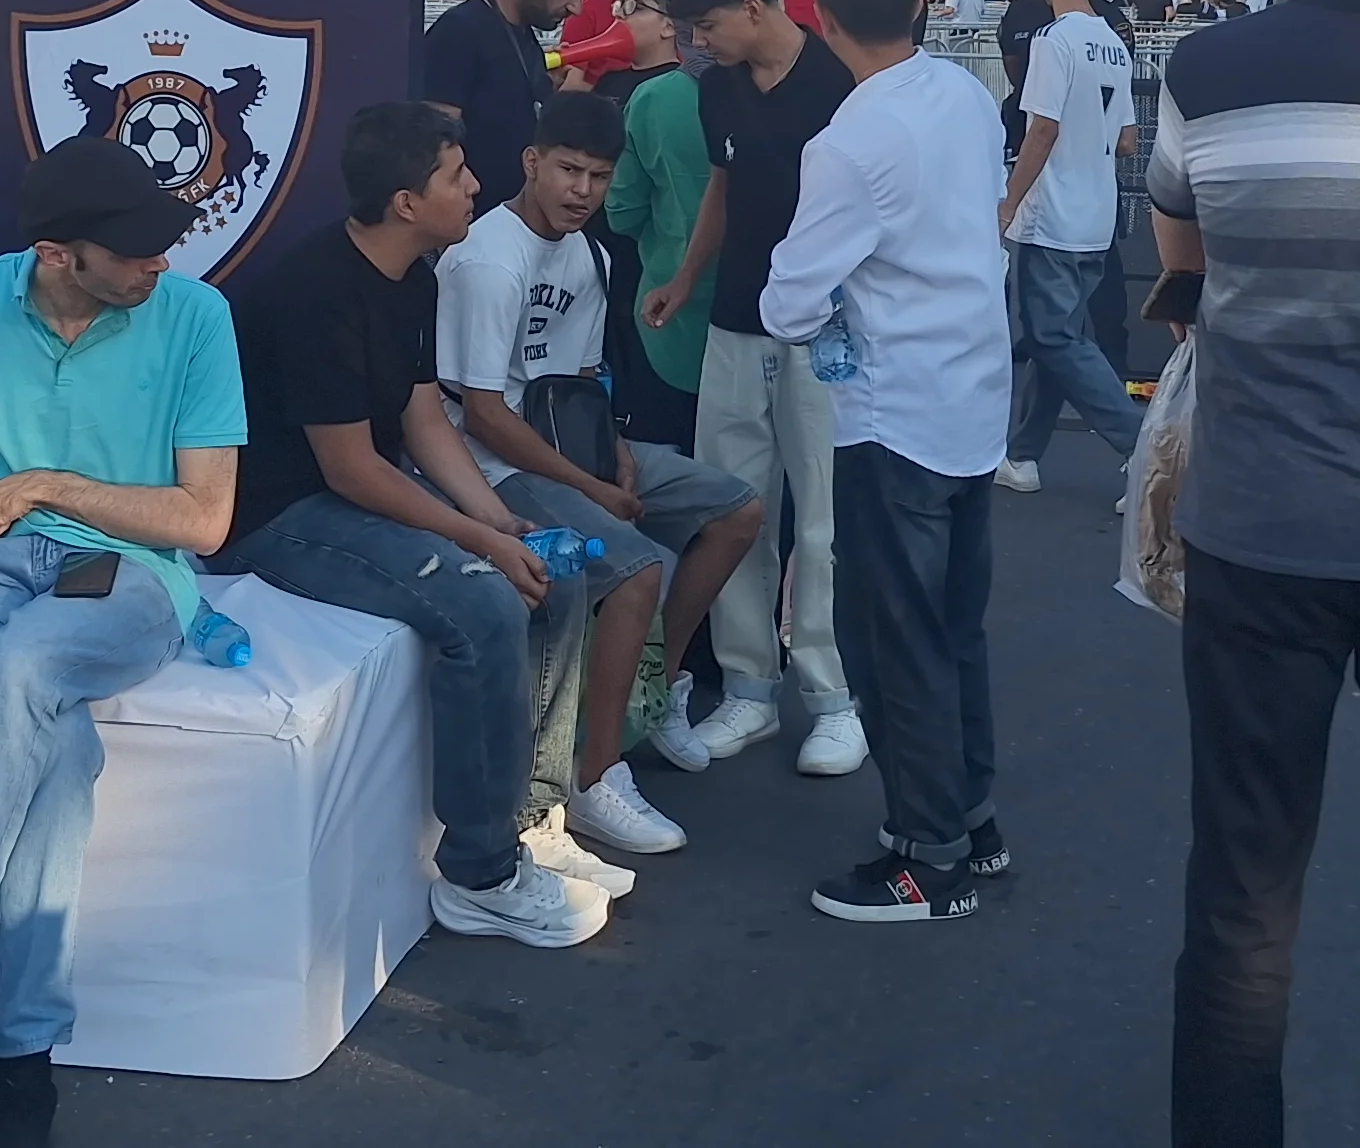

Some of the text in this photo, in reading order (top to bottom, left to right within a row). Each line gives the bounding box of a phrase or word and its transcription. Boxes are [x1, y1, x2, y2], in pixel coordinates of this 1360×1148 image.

[147, 77, 186, 91] 1987
[189, 178, 211, 199] FK
[529, 283, 575, 317] OKLYN
[523, 342, 548, 362] YORK
